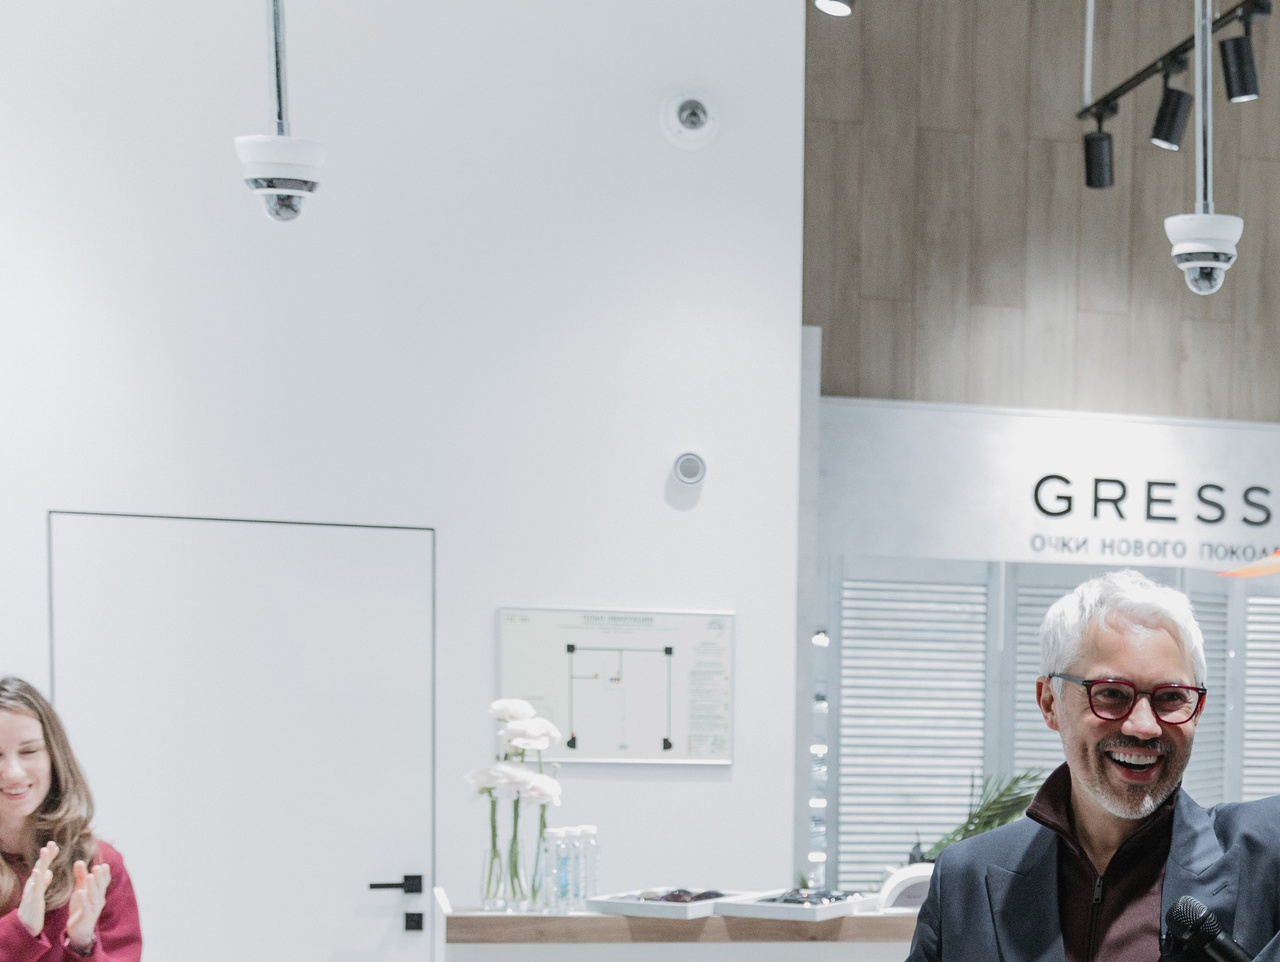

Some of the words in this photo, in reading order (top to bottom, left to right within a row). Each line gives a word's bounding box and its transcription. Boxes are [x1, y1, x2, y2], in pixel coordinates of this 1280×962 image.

[1030, 533, 1089, 555] ОЧКИ
[1100, 537, 1187, 559] НОВОГО
[1199, 542, 1280, 562] ПОКОЛ
